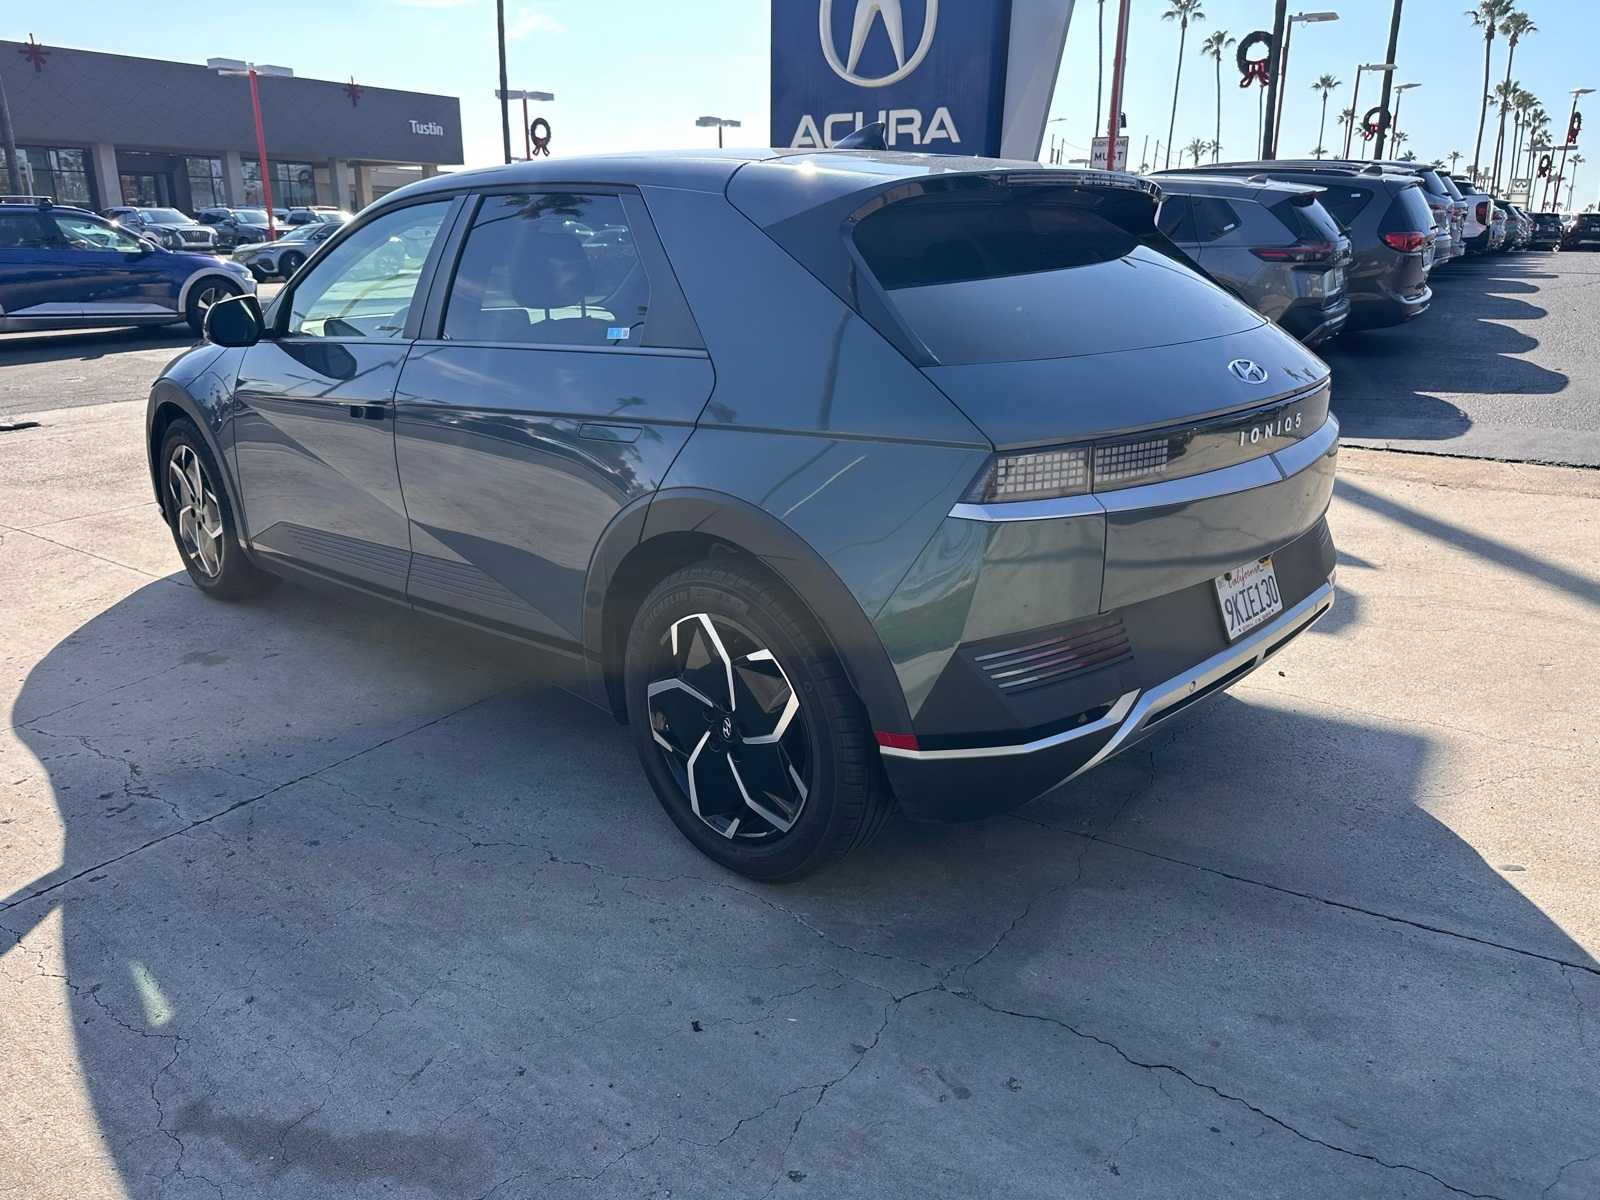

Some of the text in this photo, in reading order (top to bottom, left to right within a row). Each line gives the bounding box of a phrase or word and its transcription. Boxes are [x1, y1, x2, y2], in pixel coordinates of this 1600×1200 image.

[408, 119, 444, 136] Tustin
[1094, 151, 1123, 161] MUT
[1240, 412, 1302, 447] IONIQ 5
[1224, 575, 1279, 631] 9KIE130
